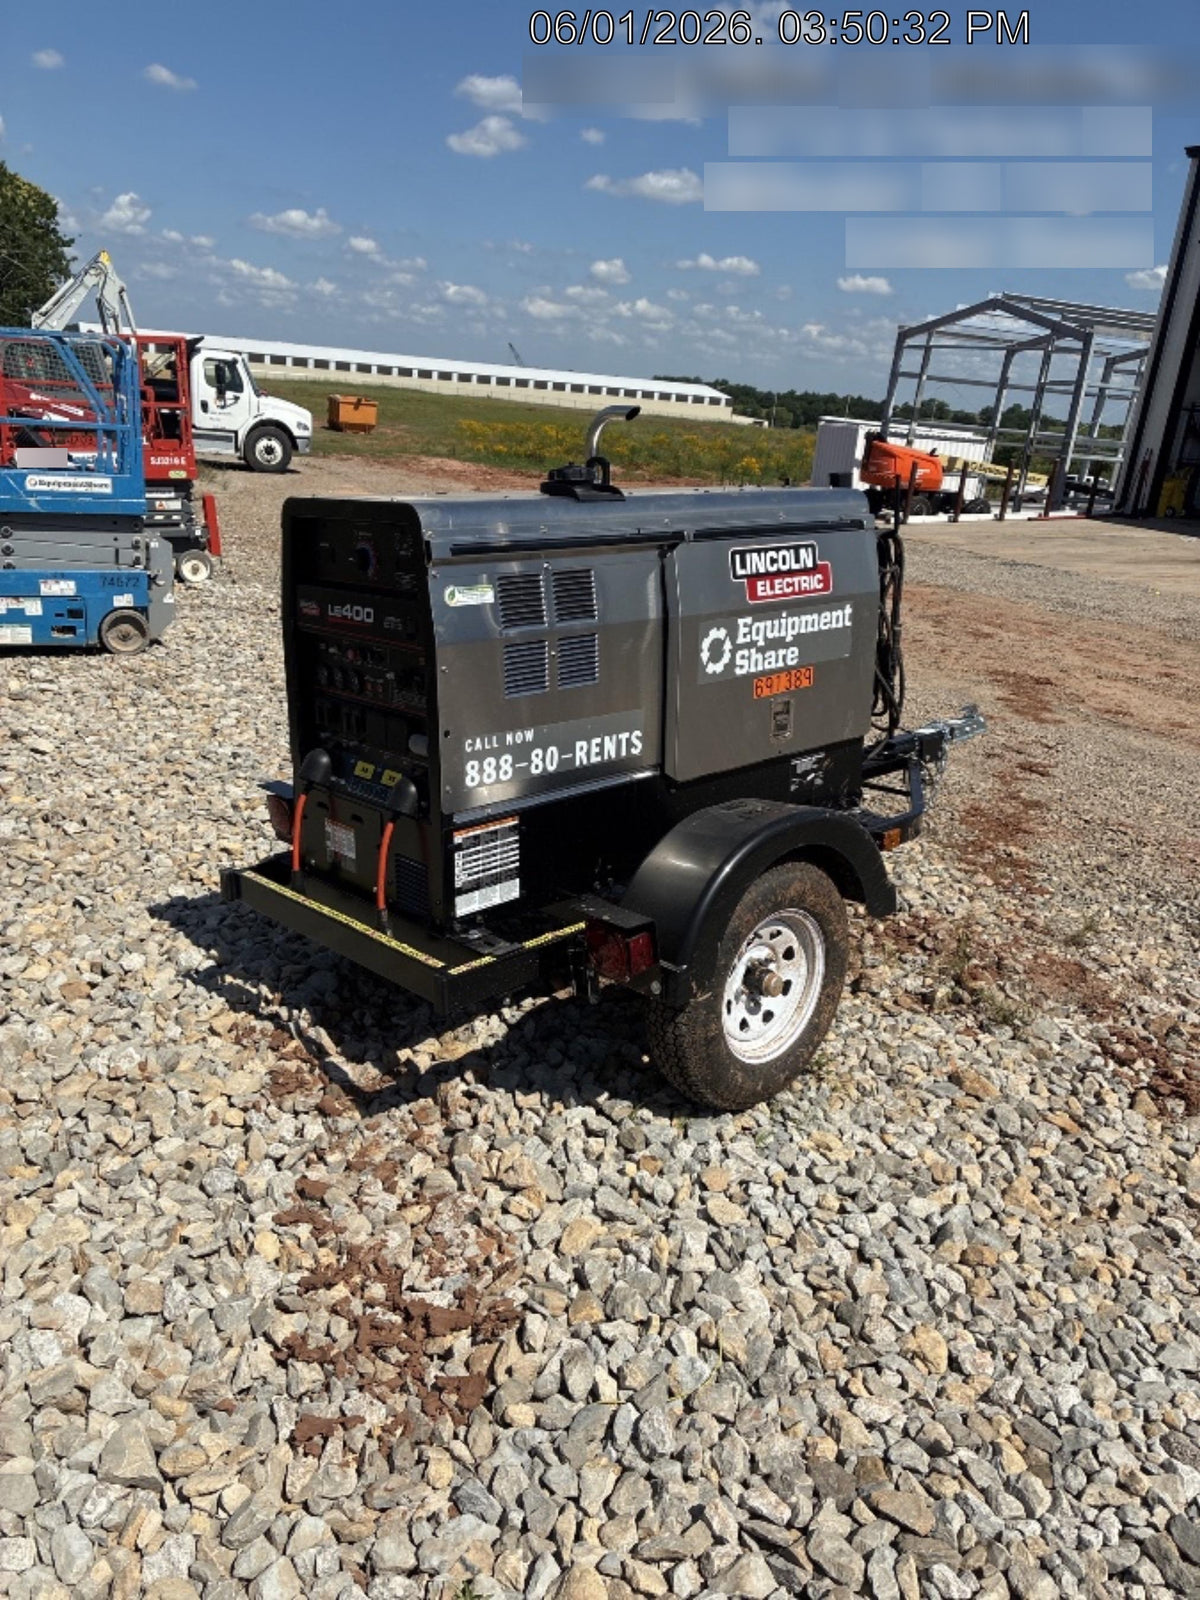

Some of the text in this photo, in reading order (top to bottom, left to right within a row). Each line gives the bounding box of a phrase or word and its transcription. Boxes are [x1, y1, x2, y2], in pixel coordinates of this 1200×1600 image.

[735, 547, 814, 576] LINCOLN
[756, 573, 824, 597] ELECTRIC
[327, 603, 375, 624] LE400
[736, 604, 853, 647] Equipment
[734, 646, 800, 676] Share
[464, 728, 535, 753] CALL NOW
[464, 730, 643, 788] 888-80-RENTS
